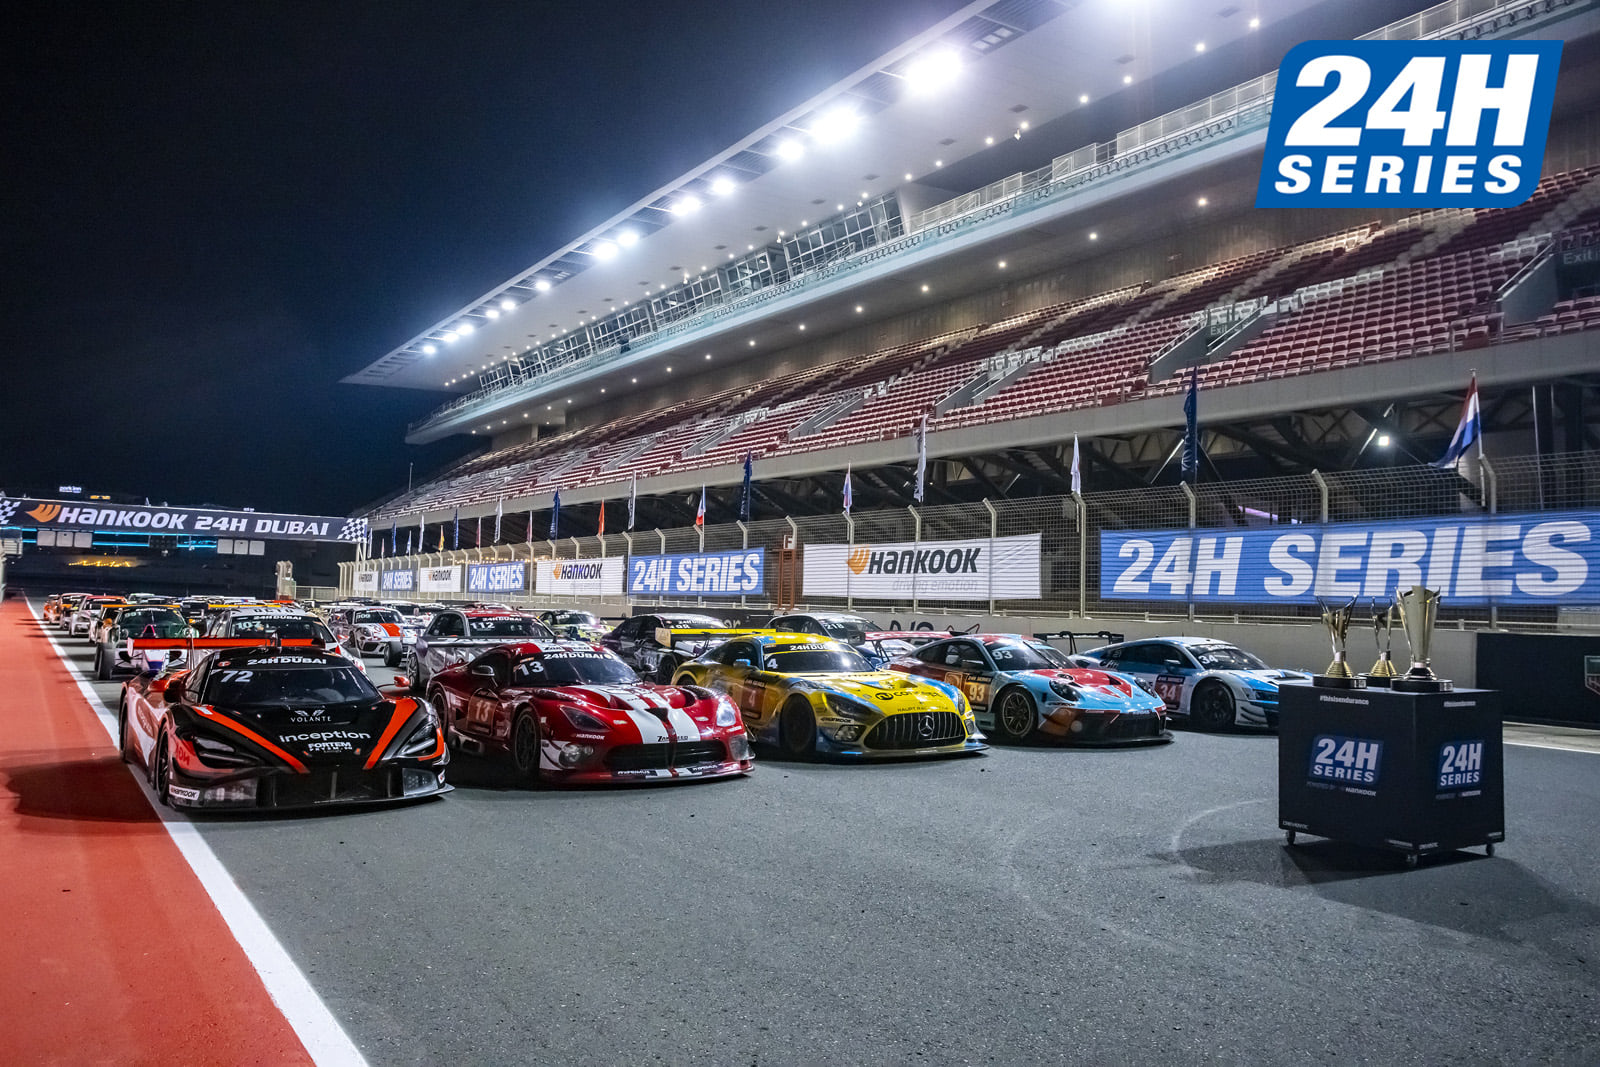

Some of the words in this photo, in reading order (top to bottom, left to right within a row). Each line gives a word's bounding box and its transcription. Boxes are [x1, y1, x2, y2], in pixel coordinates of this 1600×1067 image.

[194, 516, 248, 532] 24H
[254, 519, 329, 536] DUBAI
[1112, 536, 1244, 596] 24H
[1263, 521, 1592, 596] SERIES
[394, 570, 413, 589] SERIES
[470, 567, 488, 590] 24H
[488, 563, 523, 590] SERIES
[632, 559, 672, 591] 24H
[676, 553, 760, 591] SERIES
[892, 579, 927, 594] driving
[931, 579, 978, 592] emotion
[767, 658, 778, 669] 4
[992, 650, 1013, 660] 93
[1198, 655, 1219, 665] 34
[220, 670, 254, 683] 72
[519, 661, 544, 676] 13
[969, 684, 985, 702] 93
[1160, 684, 1177, 700] 34
[290, 715, 332, 723] VOLANTE
[475, 700, 490, 722] 13
[278, 730, 371, 743] inception
[1315, 738, 1379, 771] 24H
[1441, 743, 1482, 773] 24H
[1313, 764, 1374, 783] SERIES
[1440, 771, 1480, 787] SERIES
